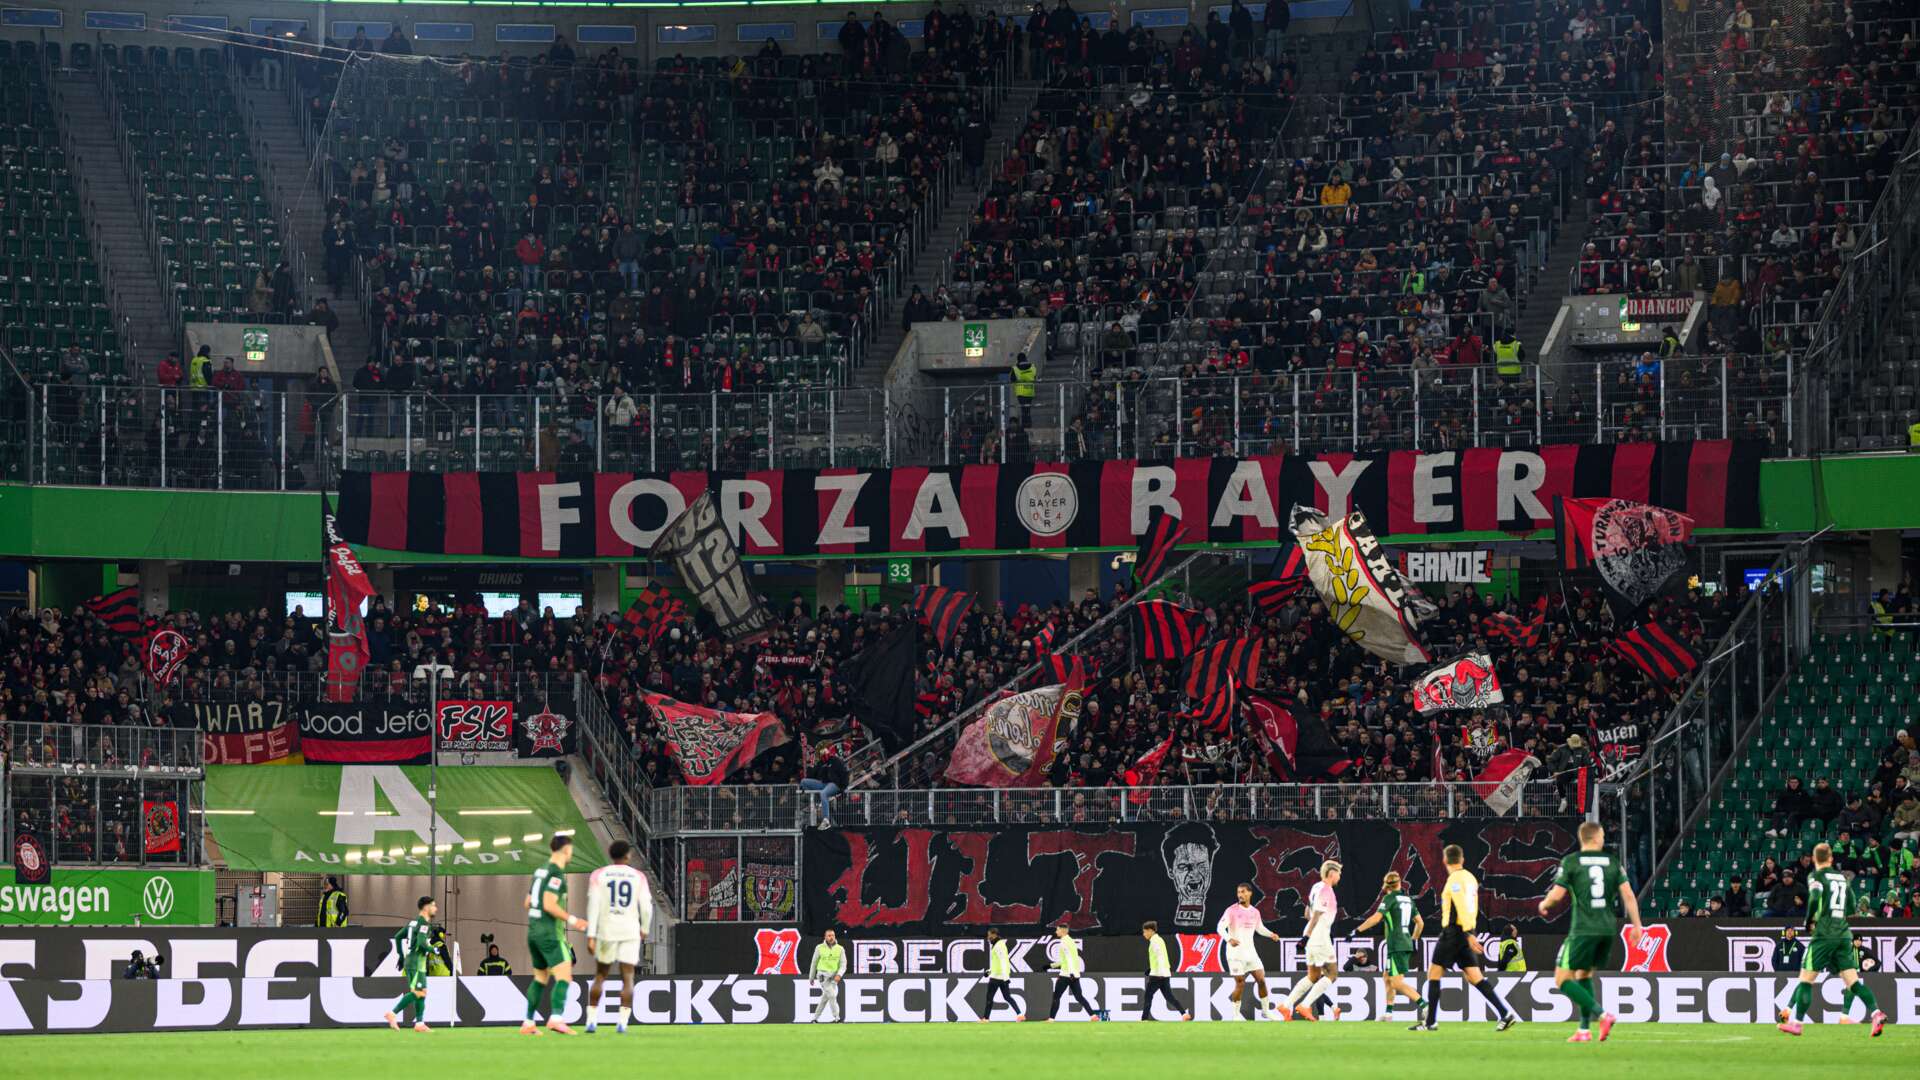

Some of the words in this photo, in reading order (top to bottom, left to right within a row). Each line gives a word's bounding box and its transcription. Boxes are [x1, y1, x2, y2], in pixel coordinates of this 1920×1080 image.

[1629, 298, 1694, 315] DJANGOS
[966, 329, 985, 343] 34
[538, 472, 970, 551] FORZA
[1131, 451, 1553, 535] BAYER
[1028, 498, 1065, 508] BAYER
[1043, 480, 1051, 527] BAYER
[478, 573, 522, 585] DRINKS
[890, 563, 910, 577] 33
[1407, 550, 1491, 583] BANDE
[301, 709, 364, 735] Jood
[375, 708, 433, 735] Jefö
[440, 704, 507, 741] FSK
[607, 880, 632, 907] 19
[1588, 865, 1605, 899] 3
[0, 885, 110, 922] swagen
